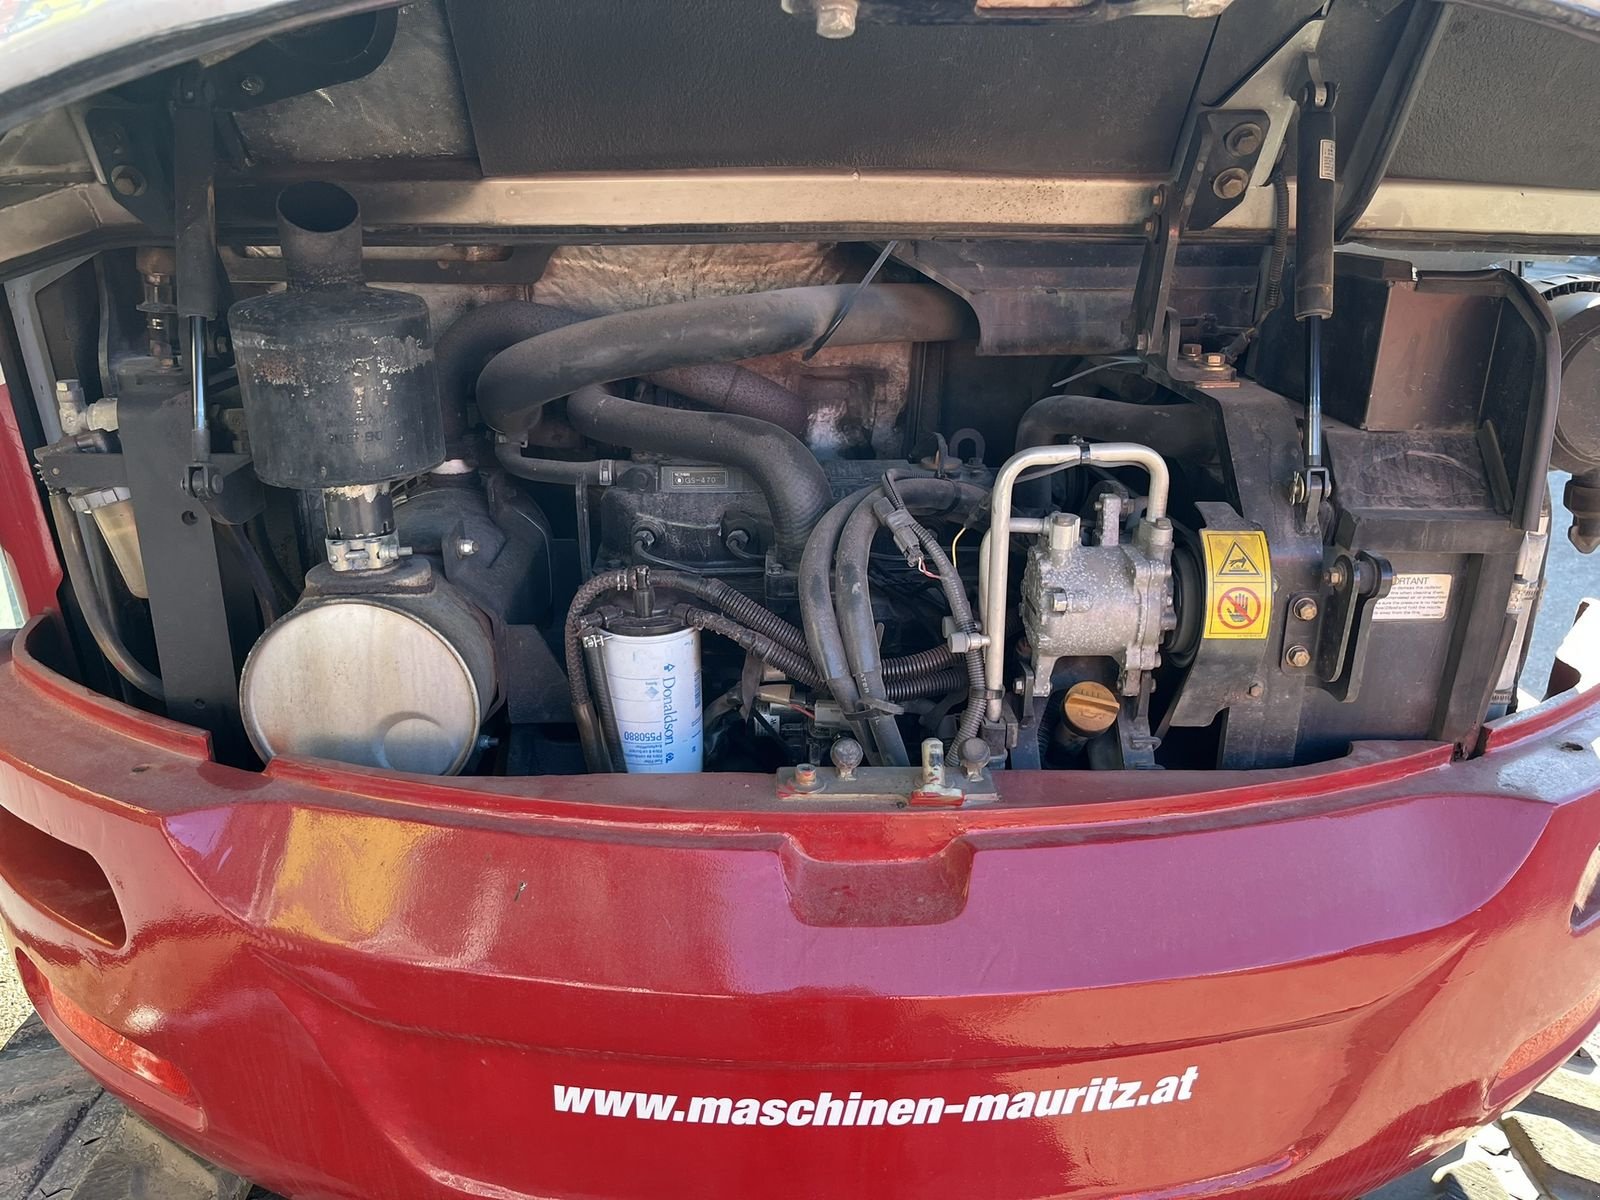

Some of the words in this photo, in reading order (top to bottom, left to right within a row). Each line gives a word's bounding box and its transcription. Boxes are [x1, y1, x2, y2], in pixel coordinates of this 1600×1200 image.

[1394, 577, 1429, 585] ORTANT
[662, 676, 678, 745] Donaldson
[624, 731, 662, 742] P550880
[553, 1066, 1199, 1127] www.maschinen-mauritz.at
